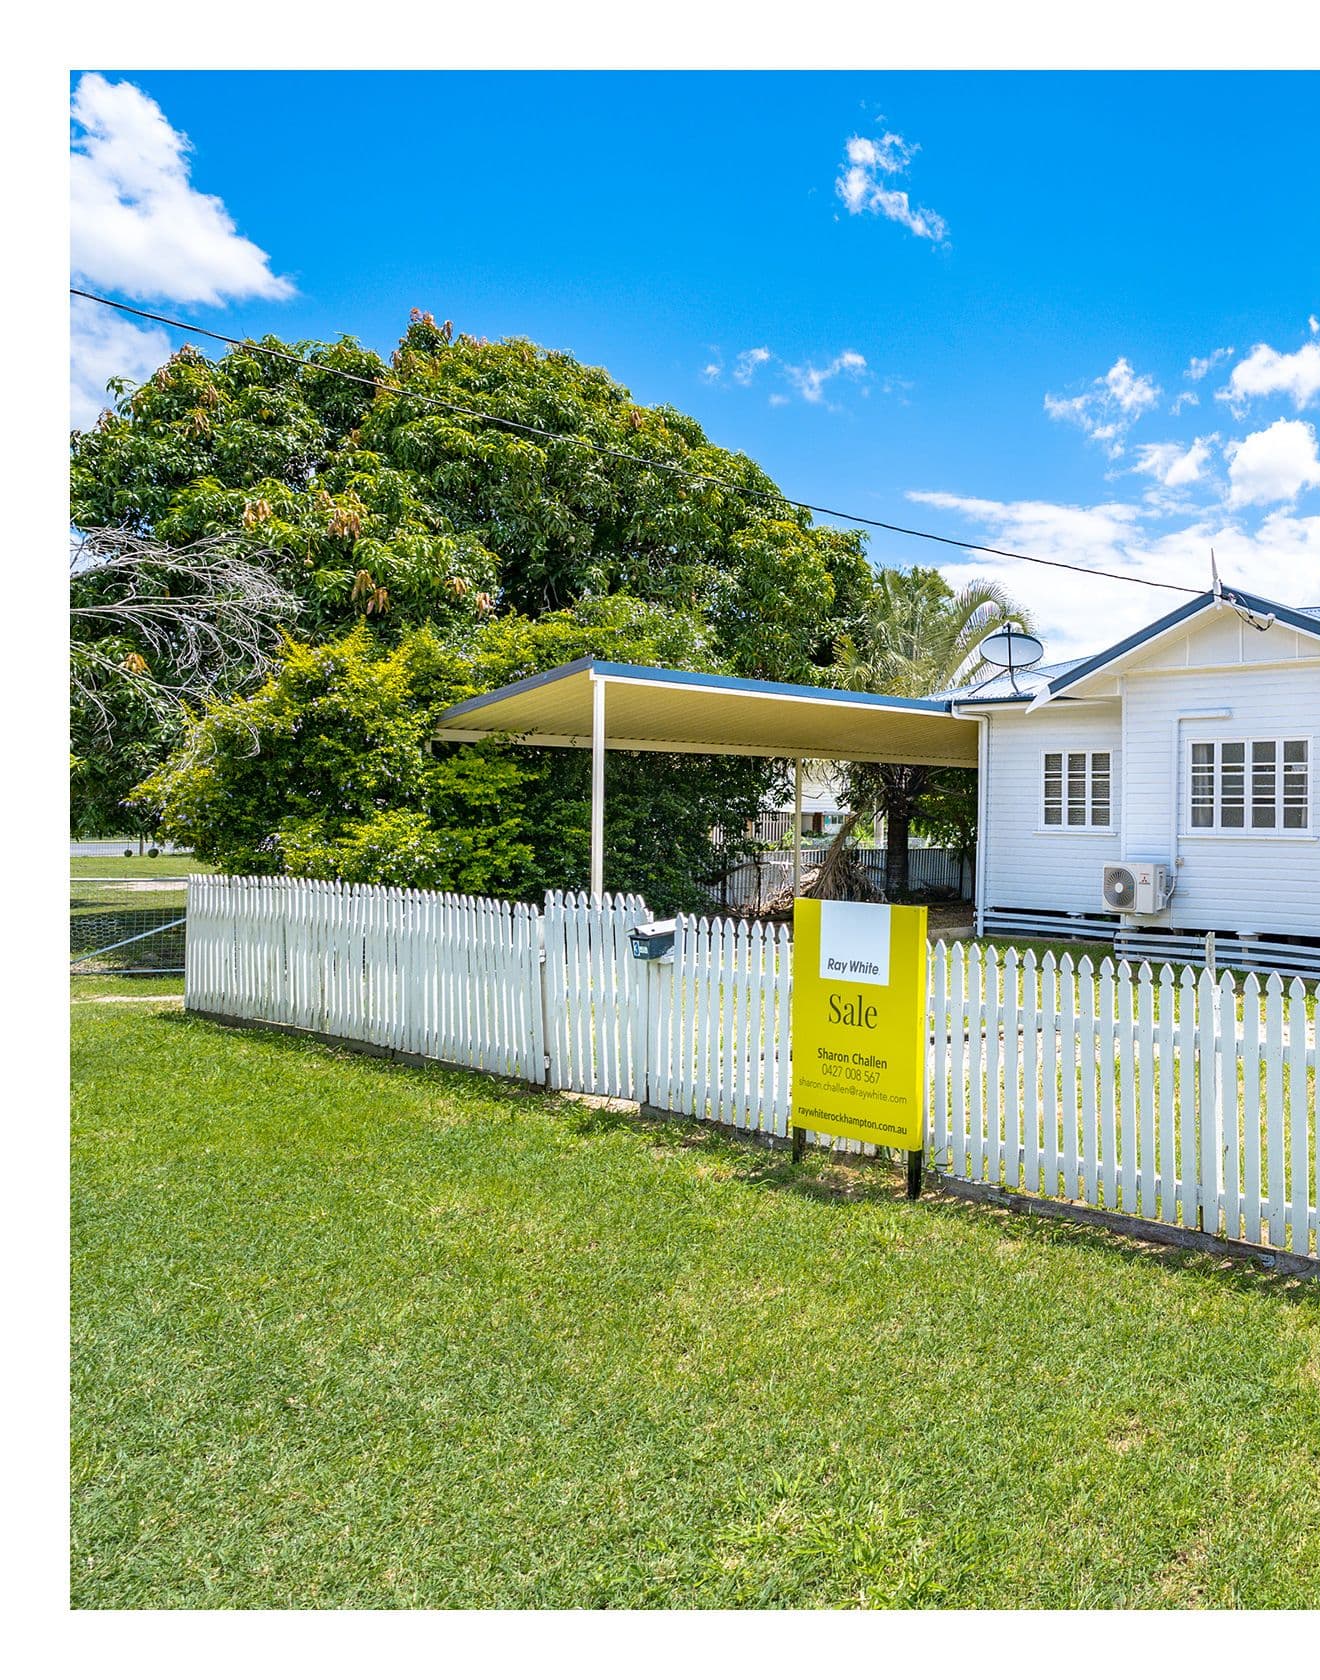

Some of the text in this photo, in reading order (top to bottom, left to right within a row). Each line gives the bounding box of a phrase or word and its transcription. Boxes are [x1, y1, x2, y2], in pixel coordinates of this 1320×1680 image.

[827, 957, 880, 976] Ray White
[828, 993, 878, 1029] Sale
[817, 1047, 888, 1069] Sharon Challen
[821, 1063, 880, 1085] 0427 008 567
[798, 1076, 908, 1105] sharon.challen@raywhite.com
[798, 1106, 908, 1135] raywhiterockhampton.com.au
